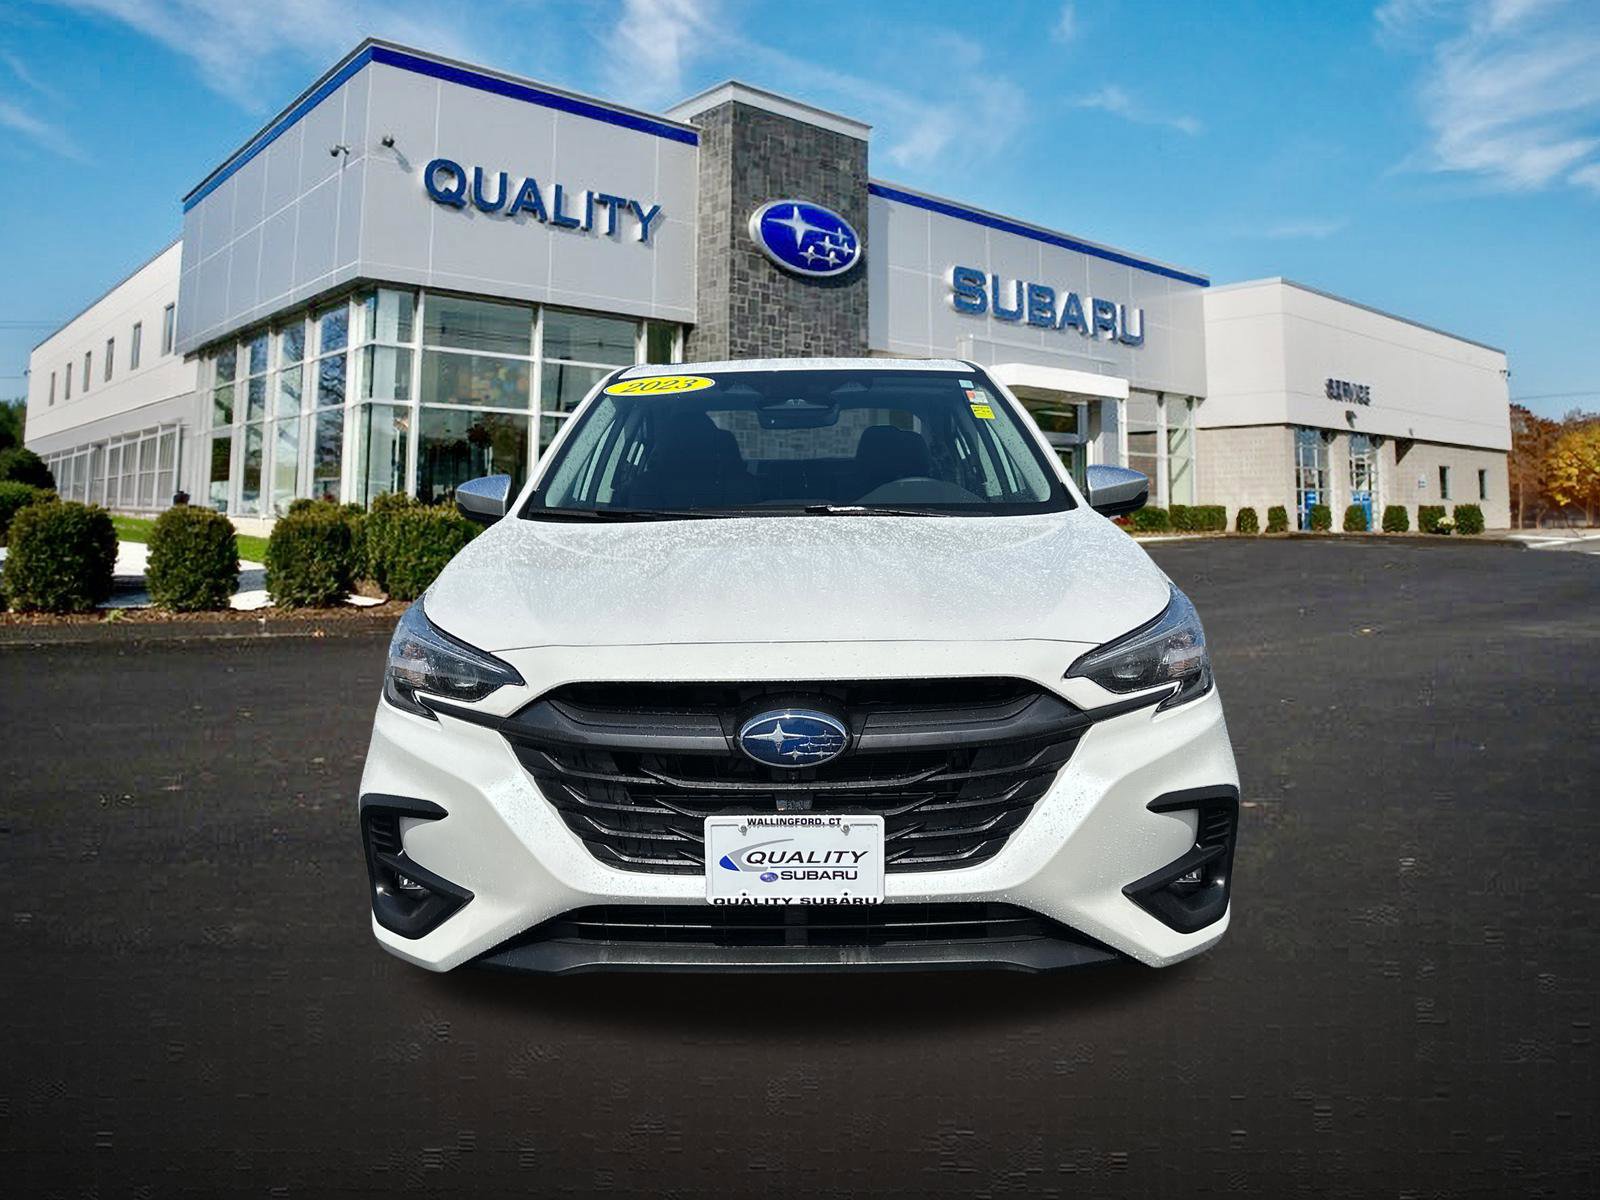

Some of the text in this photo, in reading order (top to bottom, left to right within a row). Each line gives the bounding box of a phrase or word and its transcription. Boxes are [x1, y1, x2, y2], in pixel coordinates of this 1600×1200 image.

[423, 158, 662, 243] QUALITY
[949, 265, 1145, 347] SUBARU
[619, 379, 699, 394] 2023
[828, 817, 842, 826] CT
[746, 850, 869, 865] QUALITY
[780, 870, 858, 881] SUBARU
[713, 897, 878, 905] QUALITY SUBARU
